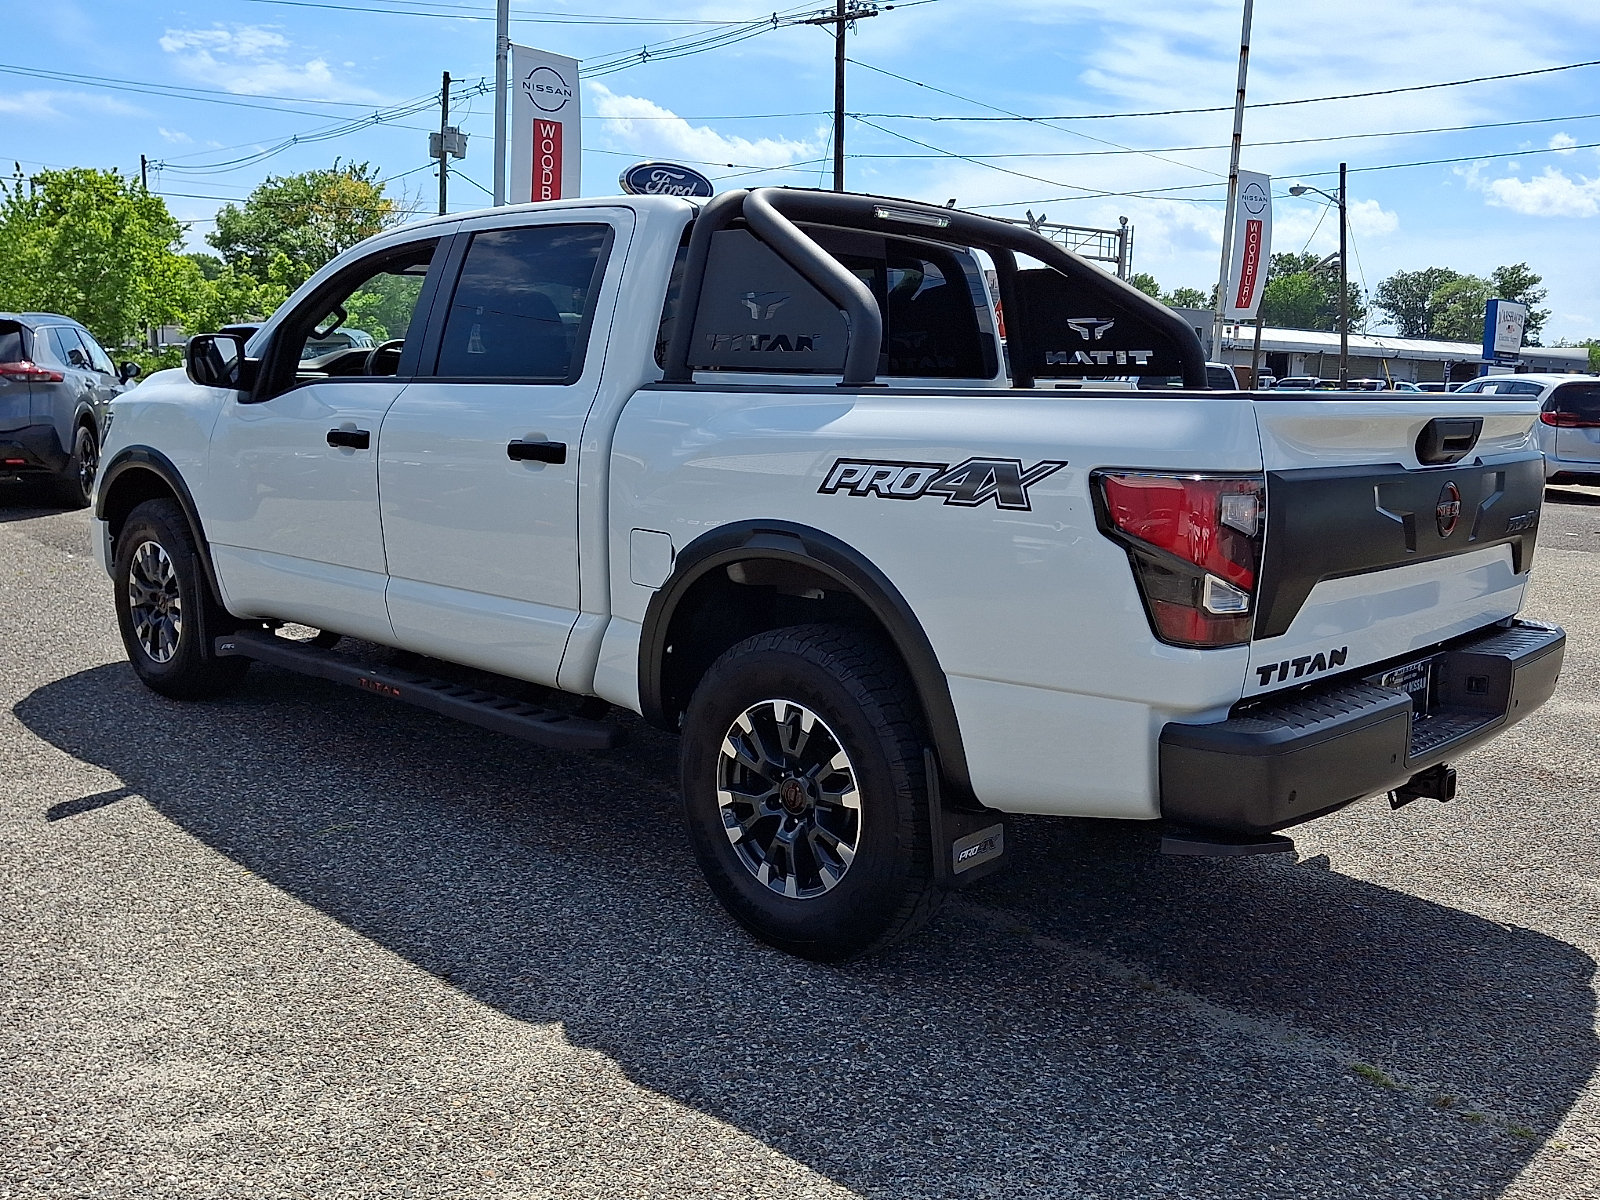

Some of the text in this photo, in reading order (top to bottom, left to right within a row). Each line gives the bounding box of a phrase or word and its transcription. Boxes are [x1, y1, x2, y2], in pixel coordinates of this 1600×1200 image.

[522, 81, 571, 97] NISSAN
[540, 123, 555, 200] WOODB
[645, 169, 697, 196] Ford
[1242, 194, 1267, 203] NISSAN
[1241, 222, 1258, 307] WOODBURY
[705, 334, 821, 352] TITAN
[1256, 646, 1348, 687] TITAN
[360, 678, 400, 697] TITAN
